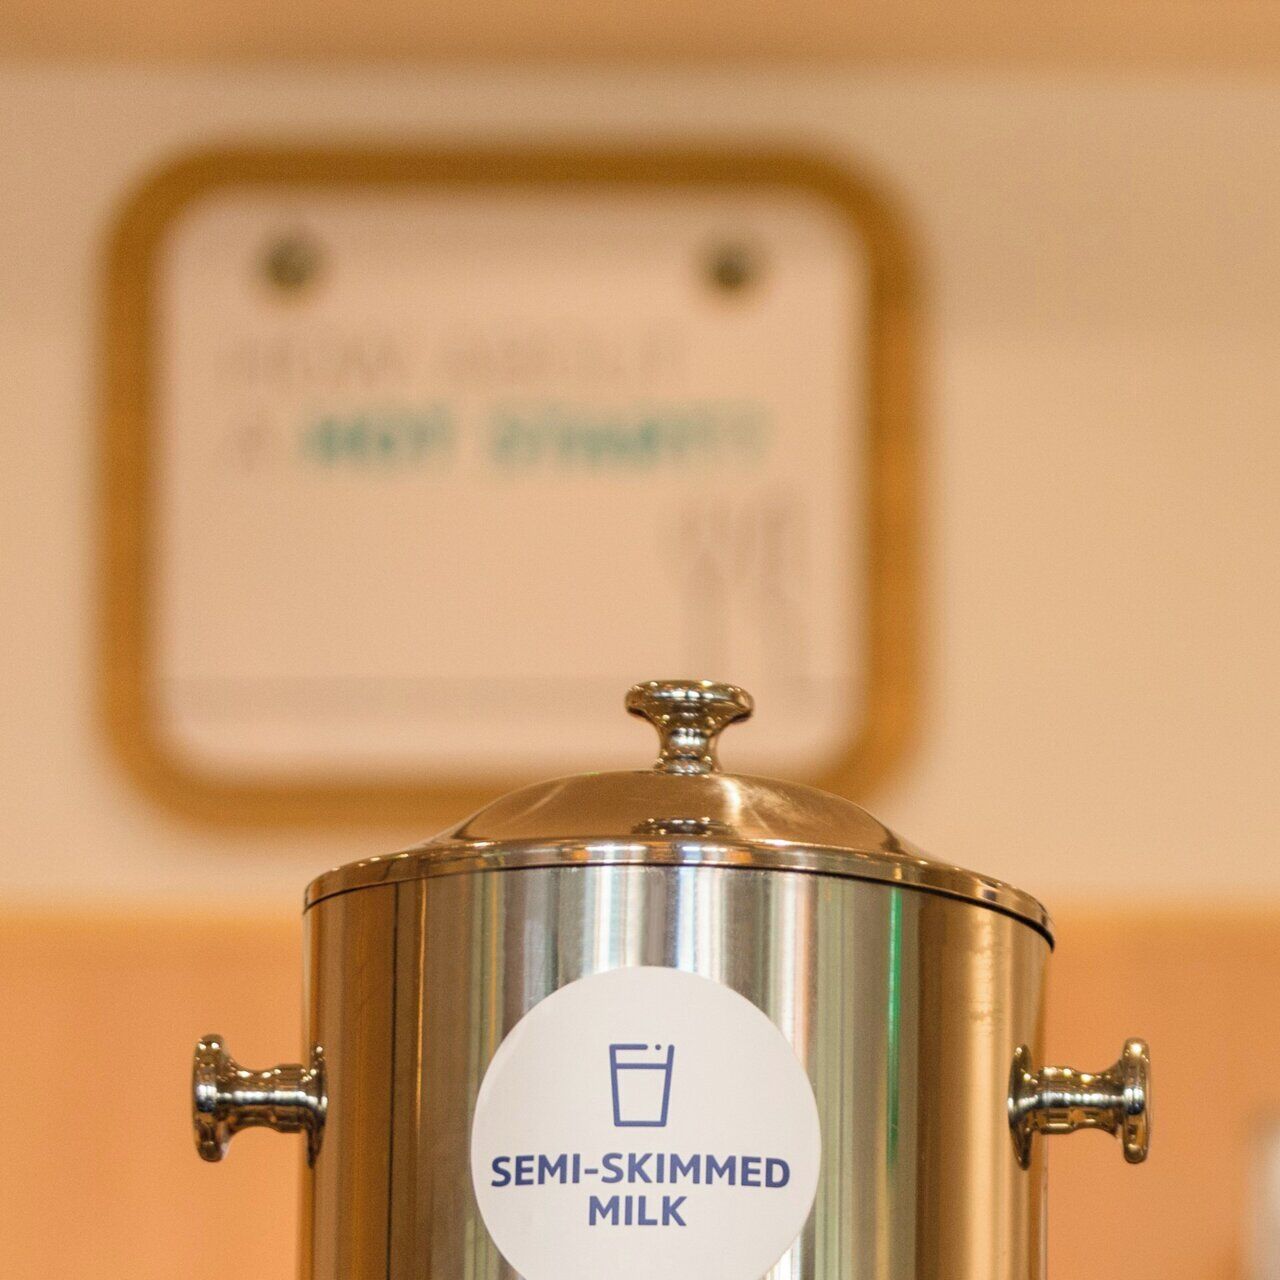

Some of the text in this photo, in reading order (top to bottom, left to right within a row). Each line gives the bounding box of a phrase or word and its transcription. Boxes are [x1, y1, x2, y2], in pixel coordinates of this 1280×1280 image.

[302, 404, 456, 474] HOT
[491, 1153, 790, 1188] SEMI-SKIMMED
[589, 1195, 687, 1226] MILK
